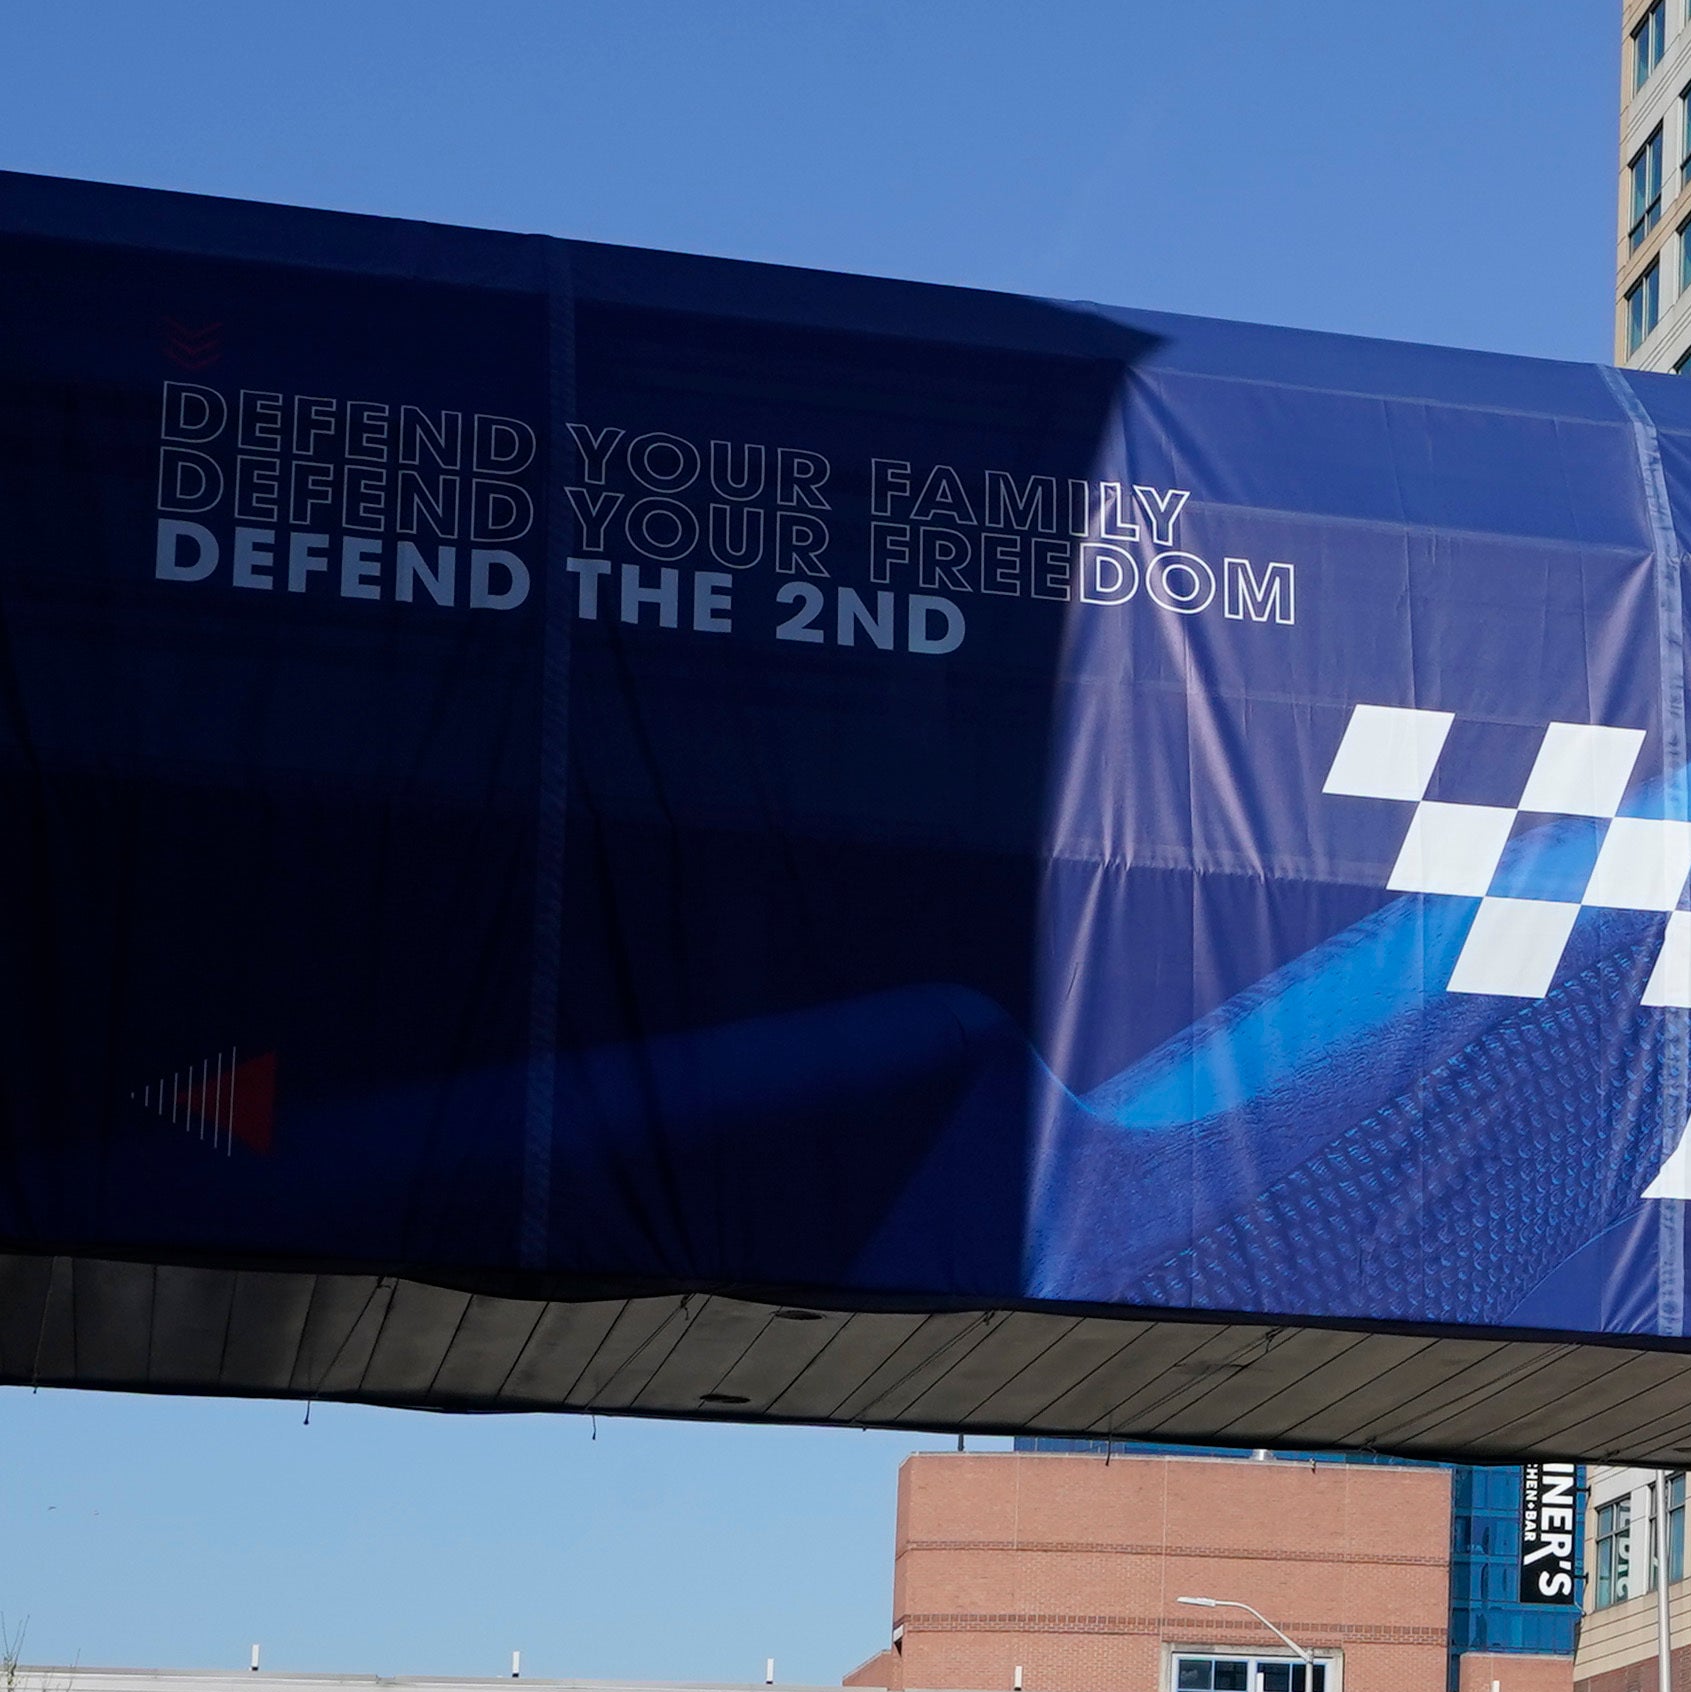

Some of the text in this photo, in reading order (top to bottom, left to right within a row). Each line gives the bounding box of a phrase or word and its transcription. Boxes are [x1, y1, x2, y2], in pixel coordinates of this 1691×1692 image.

[157, 447, 1294, 624] DEFEND YOUR FREEDOM
[161, 381, 1189, 546] DEFEND YOUR FAMILY
[156, 519, 965, 654] DEFEND THE 2ND
[1525, 1511, 1538, 1542] BAR
